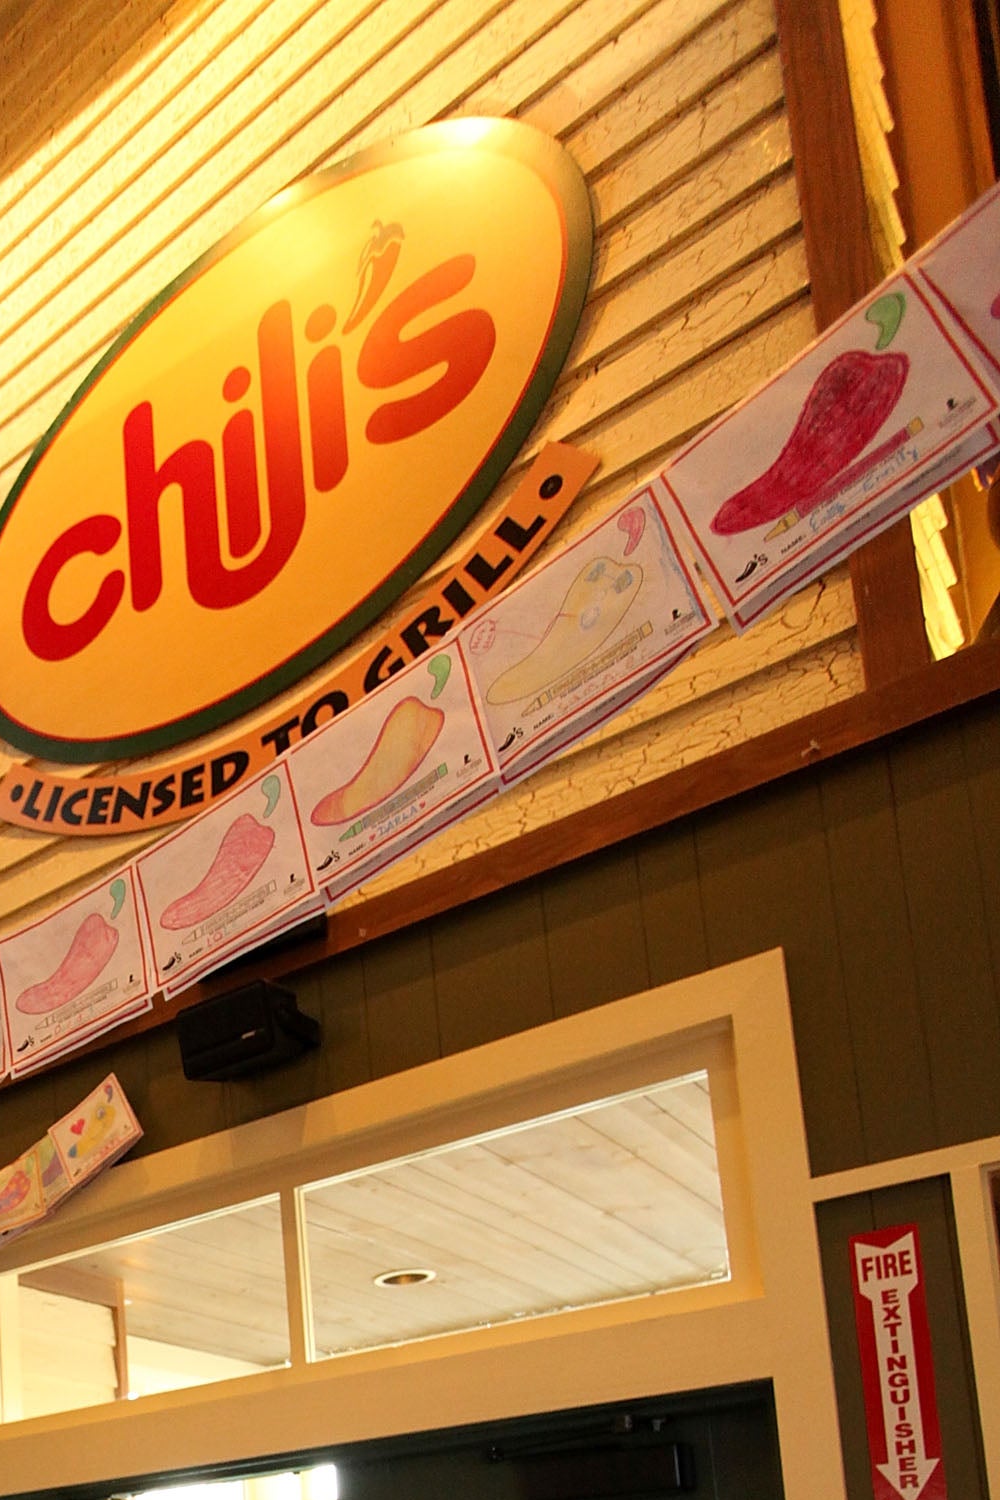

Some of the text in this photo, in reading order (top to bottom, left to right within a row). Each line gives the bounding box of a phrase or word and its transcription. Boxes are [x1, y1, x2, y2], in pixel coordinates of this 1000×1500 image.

[20, 750, 250, 826] LICENSED
[261, 690, 349, 758] TO
[363, 514, 547, 695] GRILL
[861, 1250, 913, 1283] FIRE
[881, 1289, 920, 1490] EXTINGUISHER
